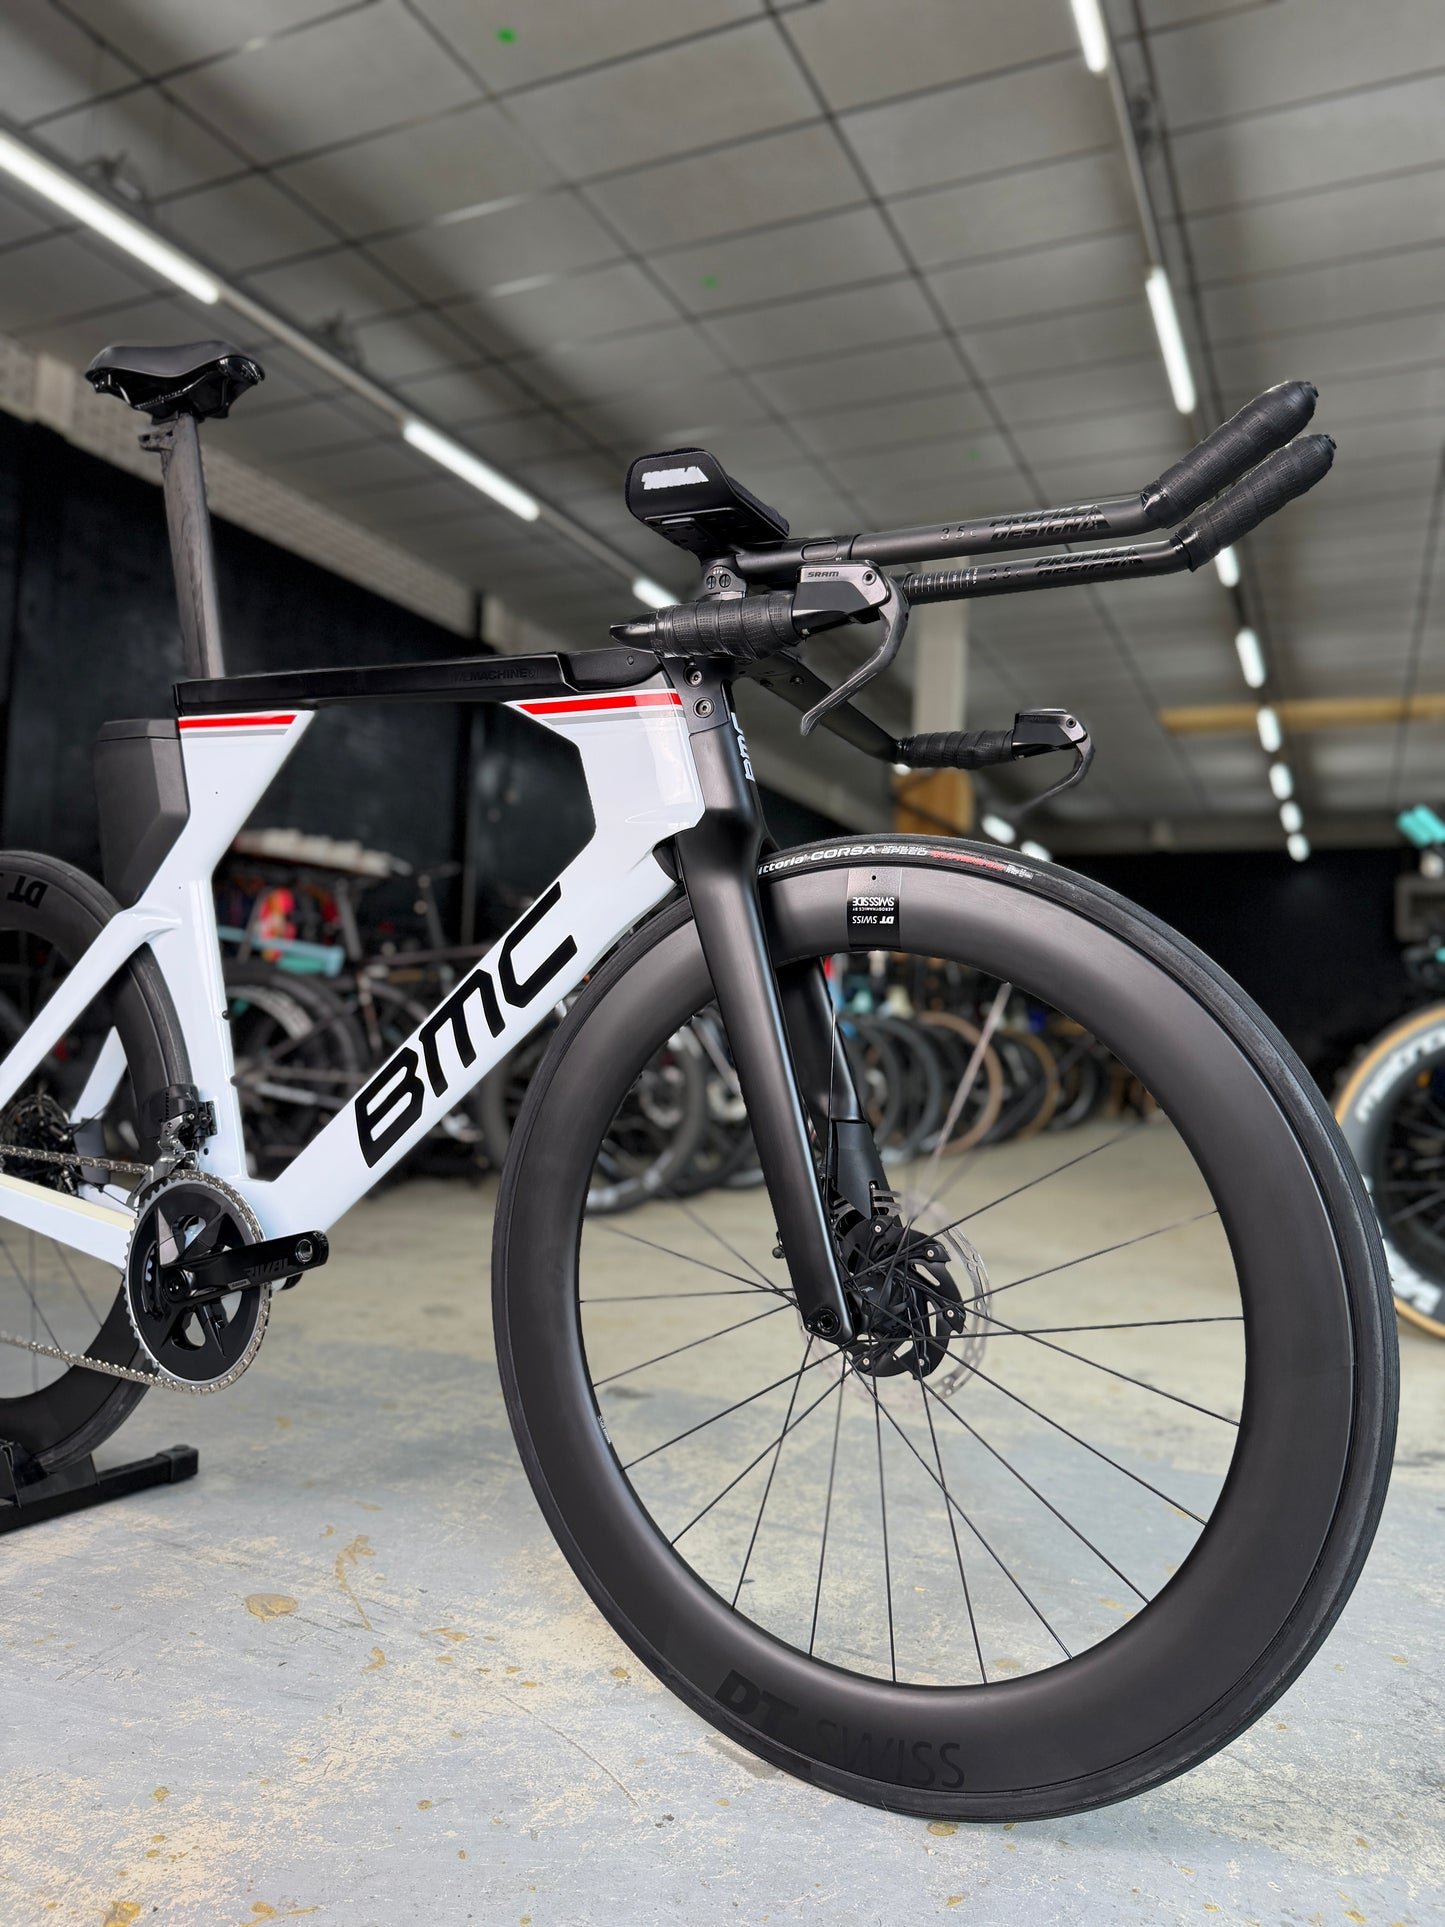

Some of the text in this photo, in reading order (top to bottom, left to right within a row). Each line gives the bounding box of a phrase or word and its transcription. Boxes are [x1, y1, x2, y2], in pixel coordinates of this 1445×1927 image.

[757, 855, 805, 876] ittoria
[810, 844, 877, 861] CORSA
[852, 915, 895, 924] DT SWISS
[355, 882, 578, 1168] BMC
[715, 1669, 799, 1735] DT
